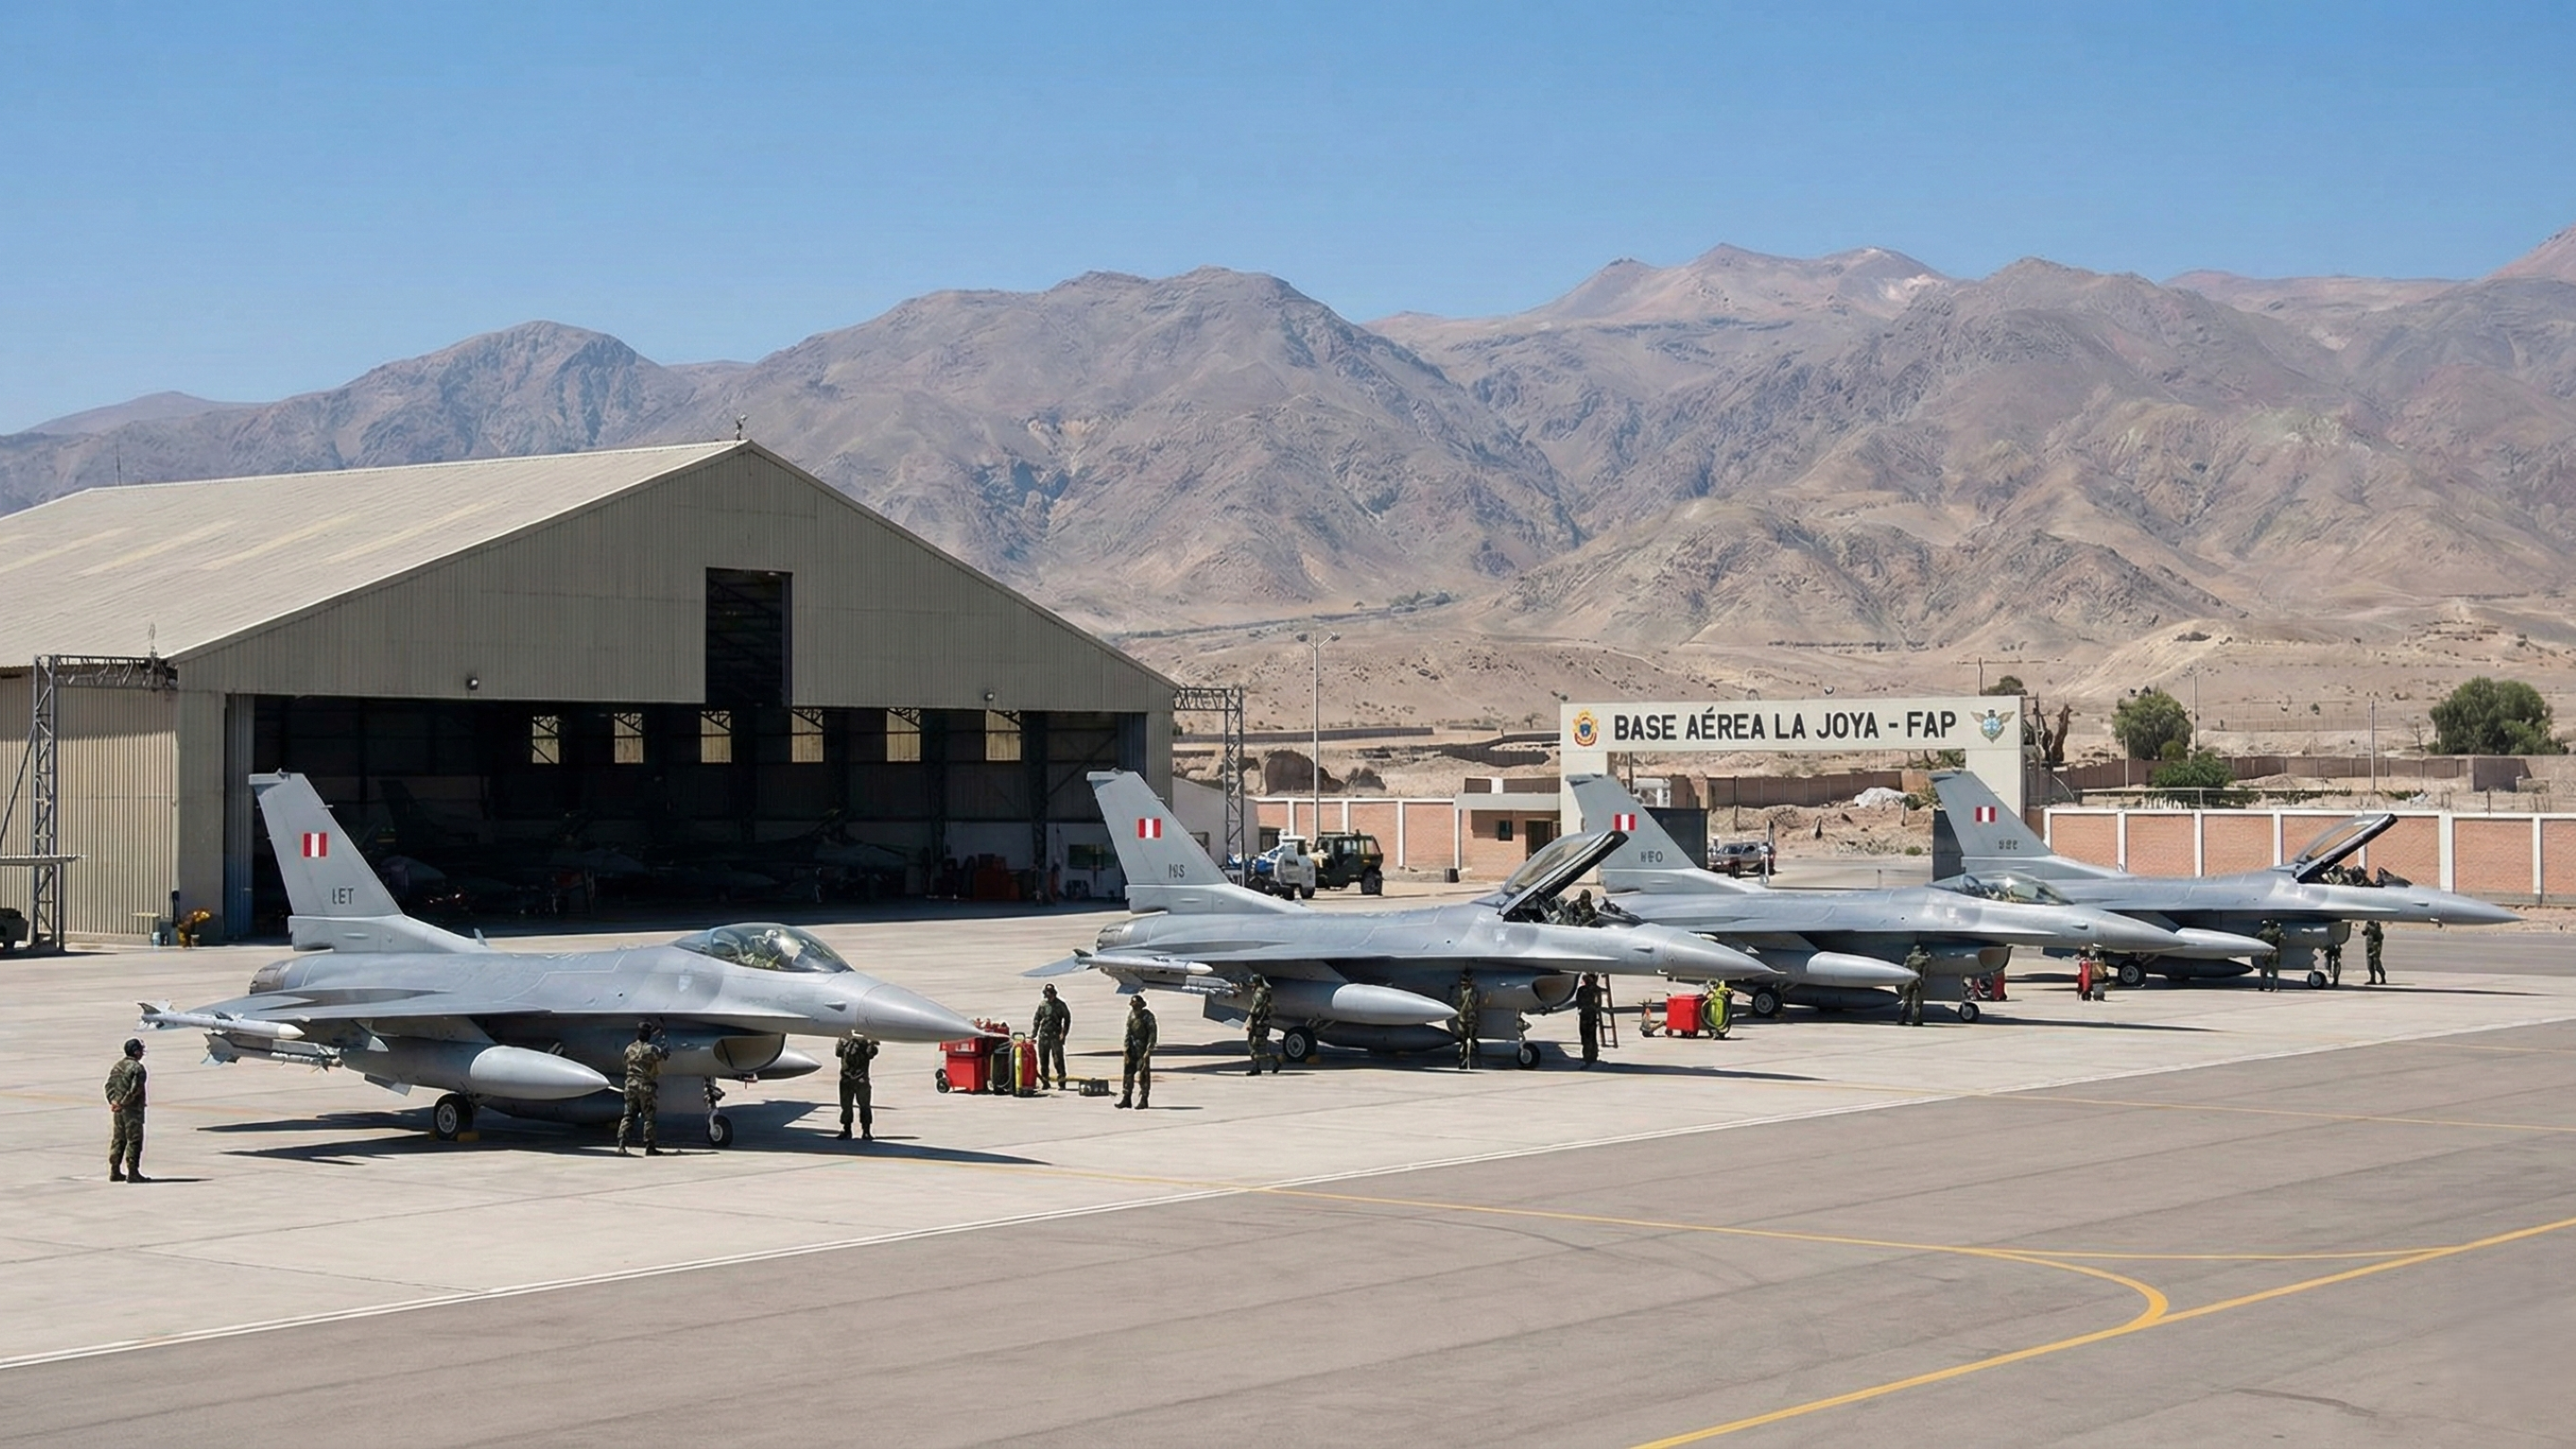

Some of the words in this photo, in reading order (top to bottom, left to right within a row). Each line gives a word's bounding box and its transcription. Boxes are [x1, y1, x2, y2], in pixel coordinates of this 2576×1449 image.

[1614, 714, 1677, 741] BASE
[1685, 706, 1766, 741] AÉREA
[1775, 713, 1807, 740] LA
[1816, 711, 1879, 740] JOYA
[1907, 710, 1957, 739] FAP
